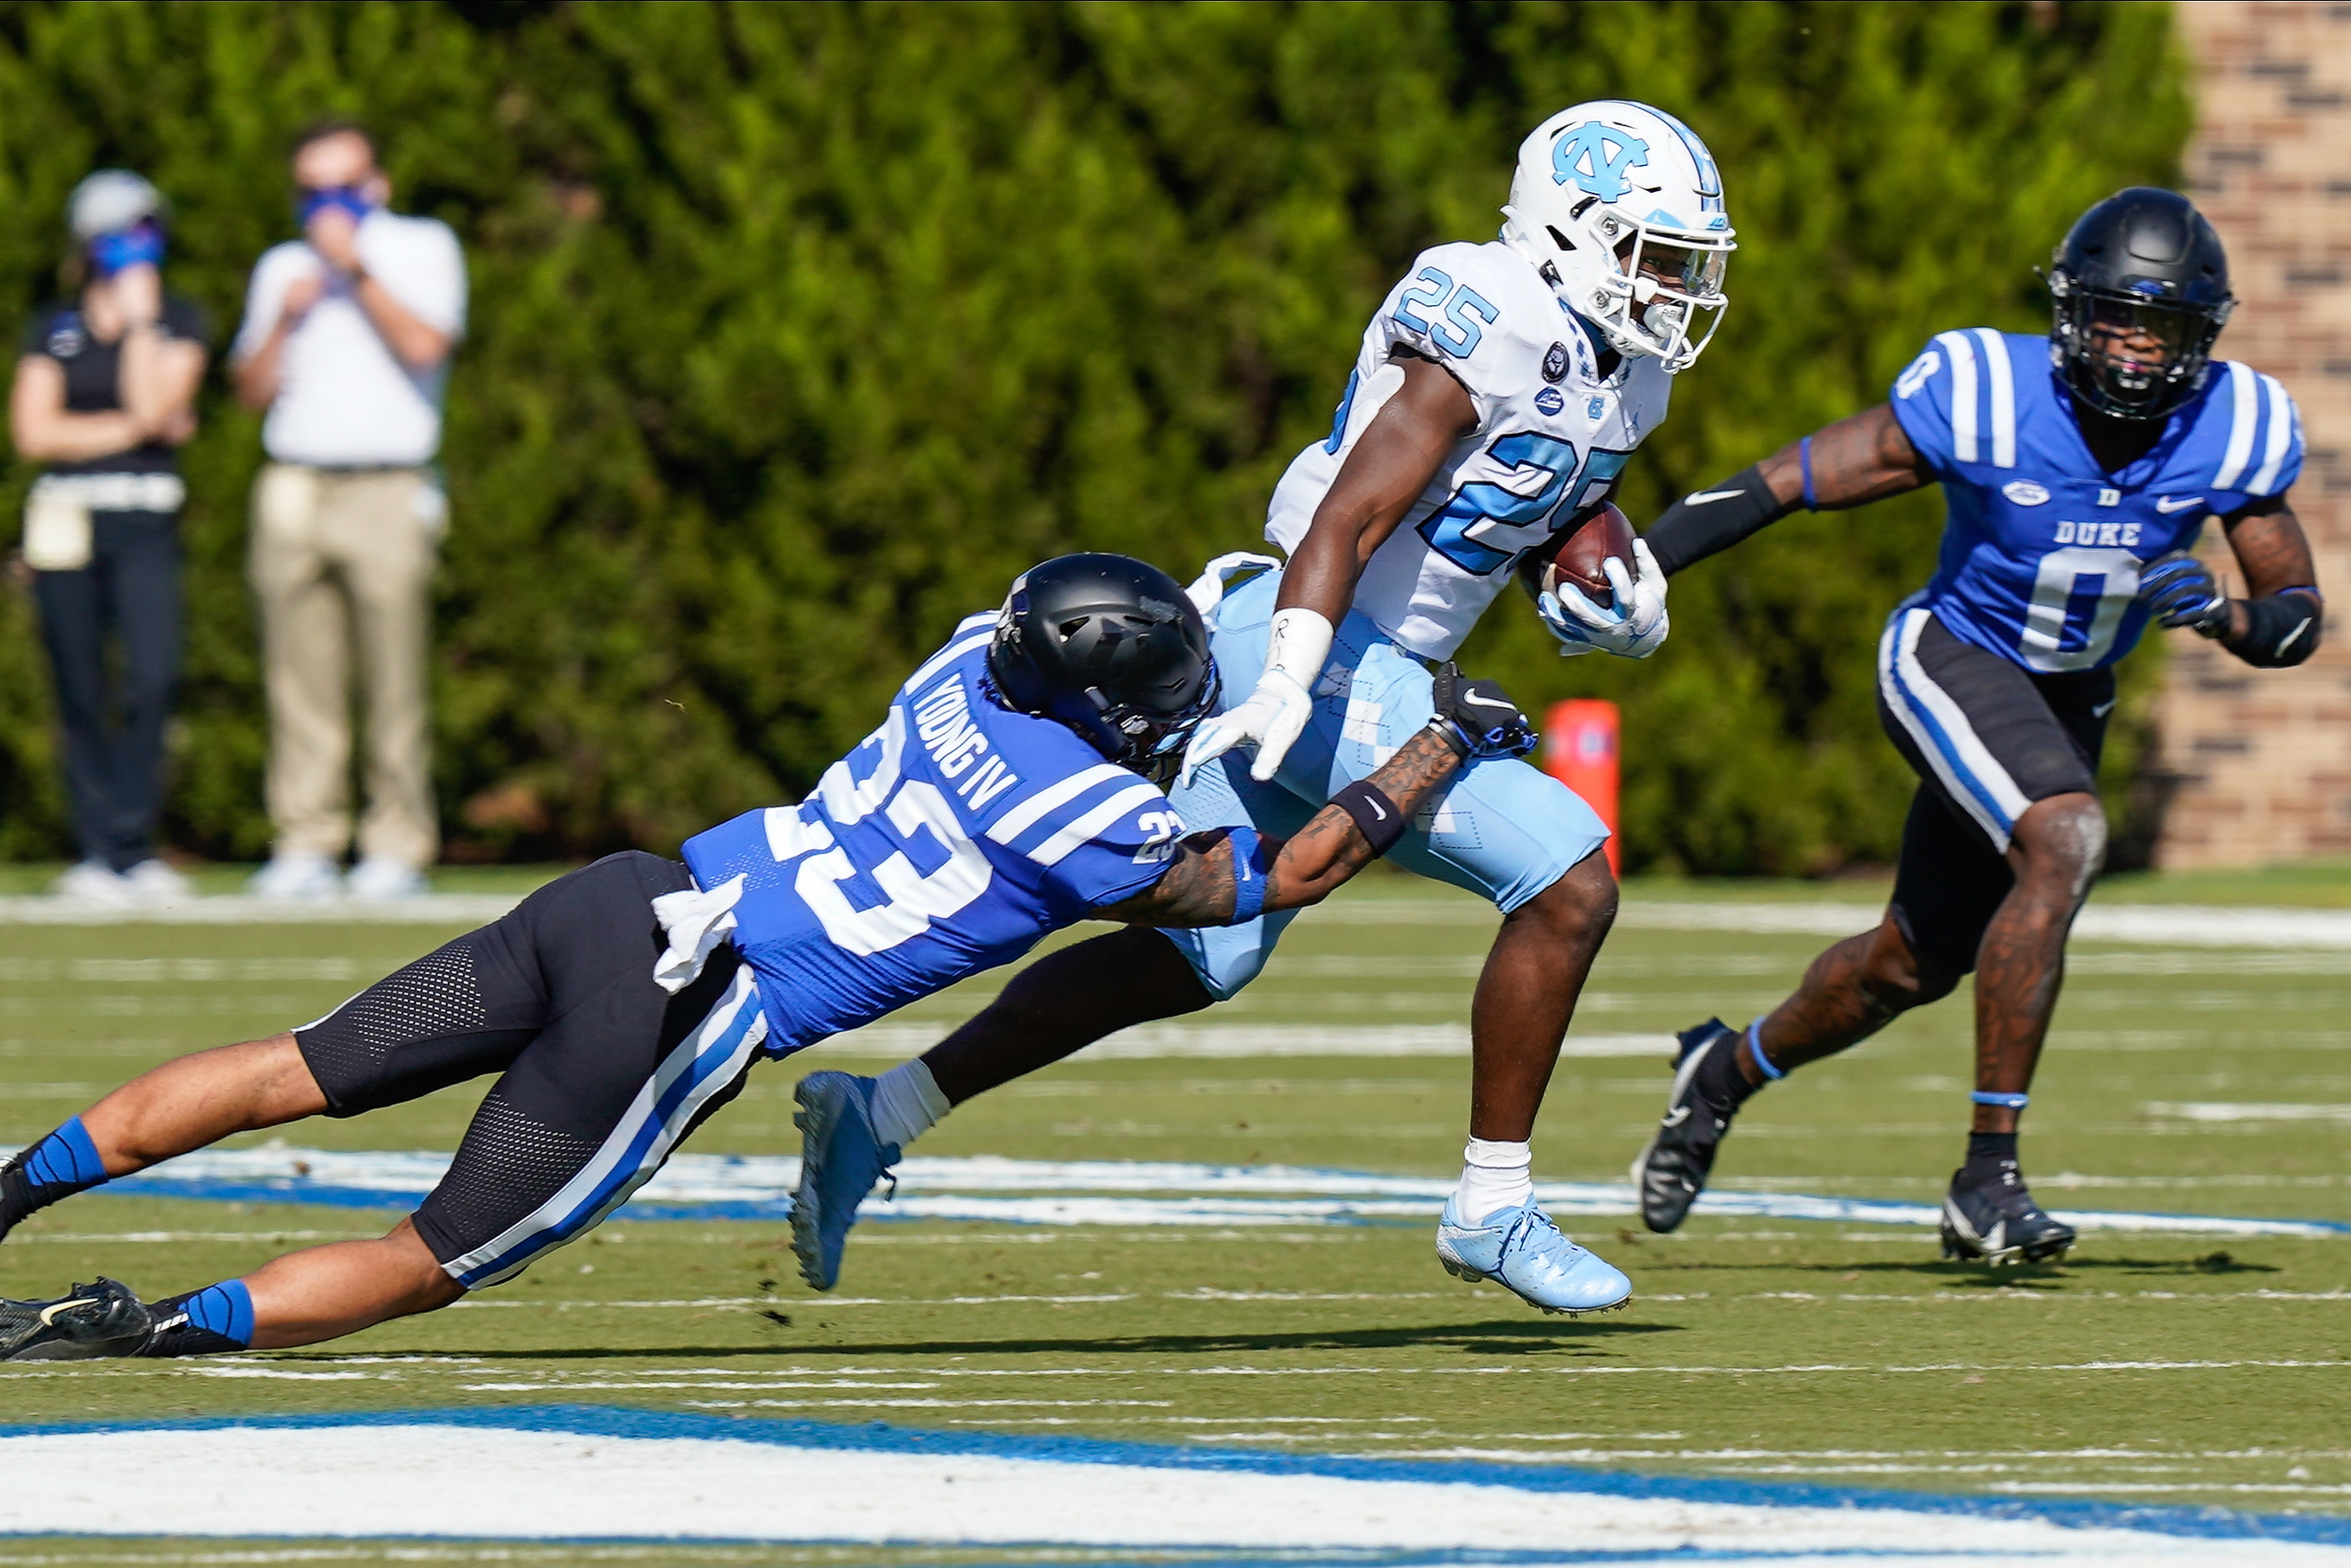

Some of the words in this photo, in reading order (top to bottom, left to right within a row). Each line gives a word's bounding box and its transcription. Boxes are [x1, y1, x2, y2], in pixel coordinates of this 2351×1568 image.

[1392, 266, 1500, 359] 25
[1895, 350, 1941, 399] 0
[2054, 520, 2142, 546] DUKE
[2097, 488, 2121, 507] D
[2017, 546, 2144, 672] 0
[913, 672, 989, 779] YOUNG
[956, 754, 1018, 811] IV
[764, 705, 994, 956] 23
[1131, 810, 1188, 864] 23
